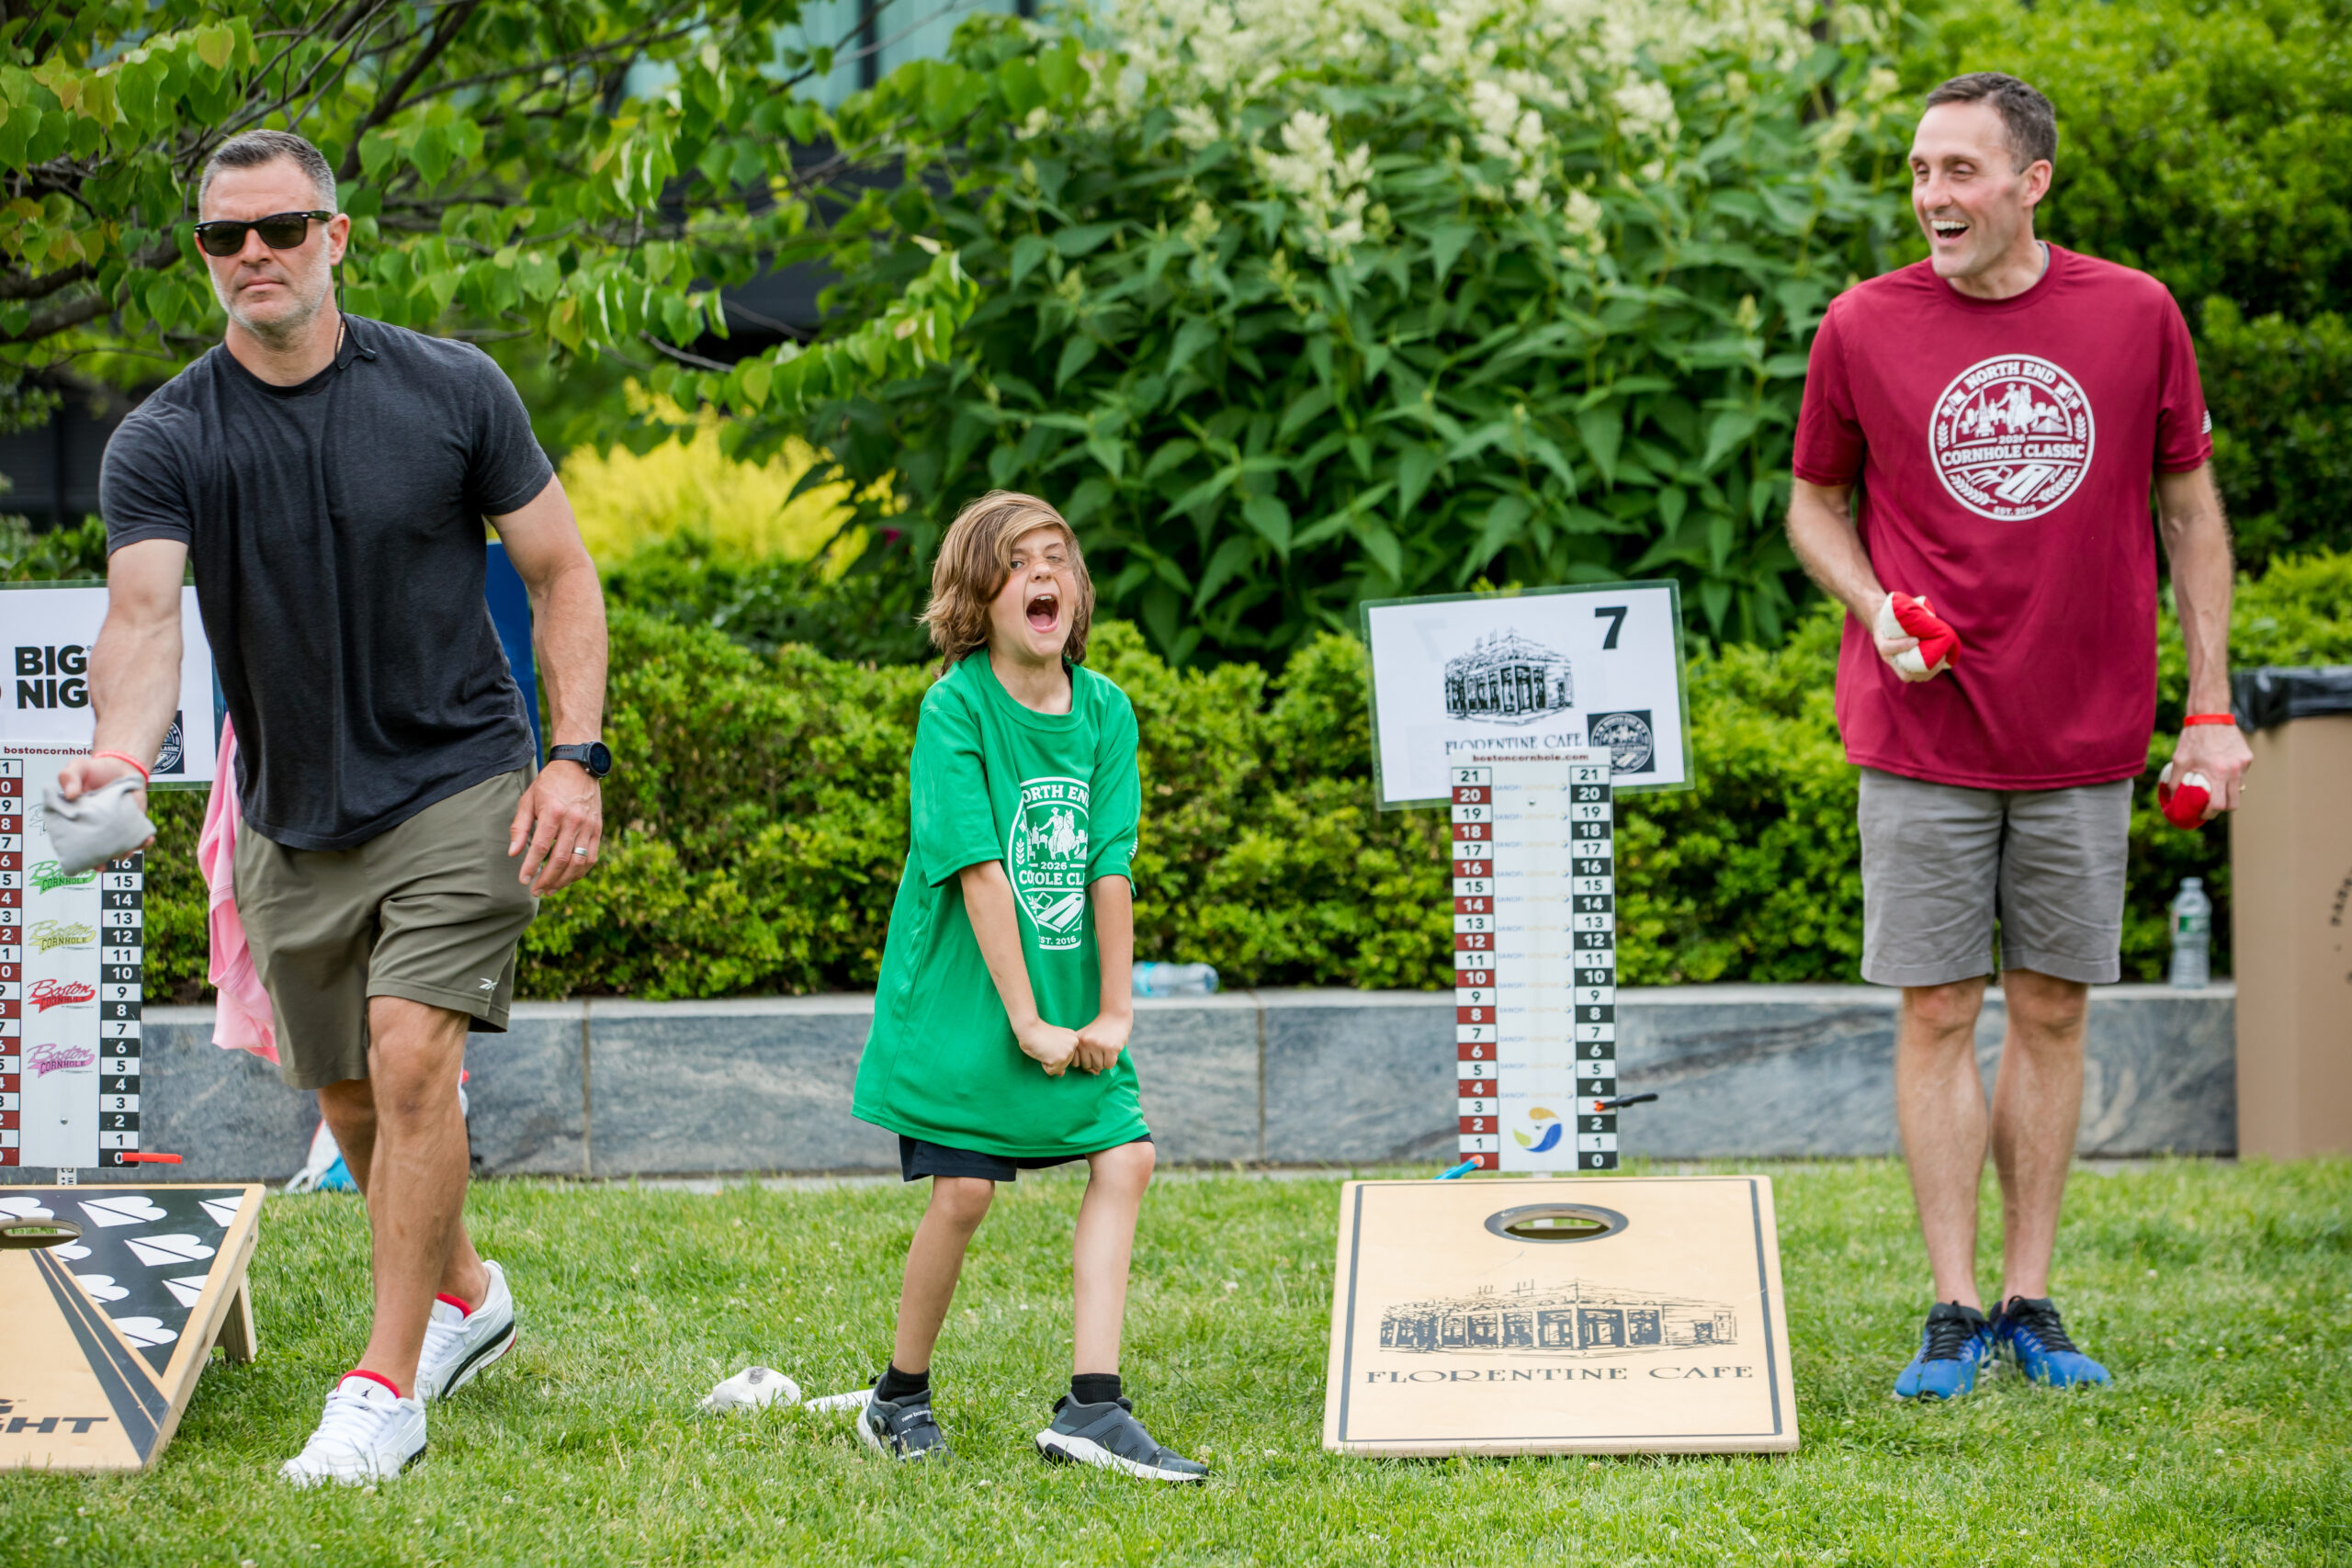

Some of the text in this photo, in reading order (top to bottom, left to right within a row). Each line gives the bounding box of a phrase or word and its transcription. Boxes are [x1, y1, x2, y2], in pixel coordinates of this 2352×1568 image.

[1963, 362, 2057, 389] NORTH END
[1940, 444, 2085, 467] CORNHOLE CLASSIC
[1594, 605, 1628, 649] 7
[15, 645, 87, 676] BIG
[16, 678, 93, 709] NIG
[1544, 733, 1582, 748] CAFE
[1473, 754, 1589, 762] bostoncornhole.com
[0, 762, 10, 773] 1
[1461, 770, 1478, 783] 21
[1579, 768, 1598, 781] 21
[1022, 784, 1090, 808] ORTH EN
[1460, 789, 1480, 802] 20
[1579, 787, 1600, 800] 20
[1463, 807, 1481, 819] 19
[1582, 806, 1600, 818] 19
[1462, 826, 1481, 838] 18
[1581, 824, 1600, 837] 18
[1464, 844, 1482, 856] 17
[1583, 842, 1601, 854] 17
[112, 859, 132, 869] 16
[1041, 862, 1068, 870] 2026
[1463, 863, 1482, 874] 16
[1582, 861, 1601, 873] 16
[114, 875, 133, 888] 15
[1465, 881, 1484, 893] 15
[1584, 879, 1602, 891] 15
[112, 893, 133, 907] 14
[1464, 899, 1484, 911] 14
[1583, 897, 1603, 910] 14
[113, 912, 133, 925] 13
[1466, 918, 1484, 930] 13
[1585, 916, 1603, 928] 13
[112, 930, 133, 943] 12
[1056, 935, 1077, 945] 2016
[1465, 935, 1485, 947] 12
[1584, 933, 1604, 946] 12
[113, 949, 130, 962] 11
[1466, 954, 1484, 965] 11
[1586, 953, 1602, 964] 11
[112, 966, 133, 980] 10
[1466, 972, 1486, 984] 10
[1585, 970, 1605, 983] 10
[27, 978, 93, 999] Boston
[117, 986, 127, 998] 9
[1590, 989, 1600, 1001] 9
[1471, 991, 1481, 1003] 9
[117, 1004, 127, 1017] 8
[1472, 1009, 1481, 1021] 8
[1590, 1007, 1600, 1020] 8
[117, 1022, 127, 1035] 7
[1472, 1027, 1481, 1039] 7
[1591, 1026, 1600, 1038] 7
[27, 1043, 92, 1064] Boston
[116, 1041, 127, 1055] 6
[1472, 1045, 1482, 1058] 6
[1590, 1044, 1601, 1057] 6
[116, 1060, 126, 1073] 5
[1474, 1064, 1482, 1077] 5
[1592, 1063, 1601, 1075] 5
[115, 1077, 127, 1091] 4
[1473, 1082, 1483, 1094] 4
[1591, 1081, 1602, 1093] 4
[116, 1097, 126, 1110] 3
[1475, 1100, 1483, 1113] 3
[114, 1114, 125, 1128] 2
[1474, 1118, 1483, 1131] 2
[1592, 1117, 1602, 1130] 2
[116, 1134, 123, 1146] 1
[1476, 1137, 1482, 1149] 1
[1595, 1136, 1601, 1147] 1
[1592, 1154, 1603, 1167] 0
[1365, 1365, 1753, 1383] FLORENTINE CAFE
